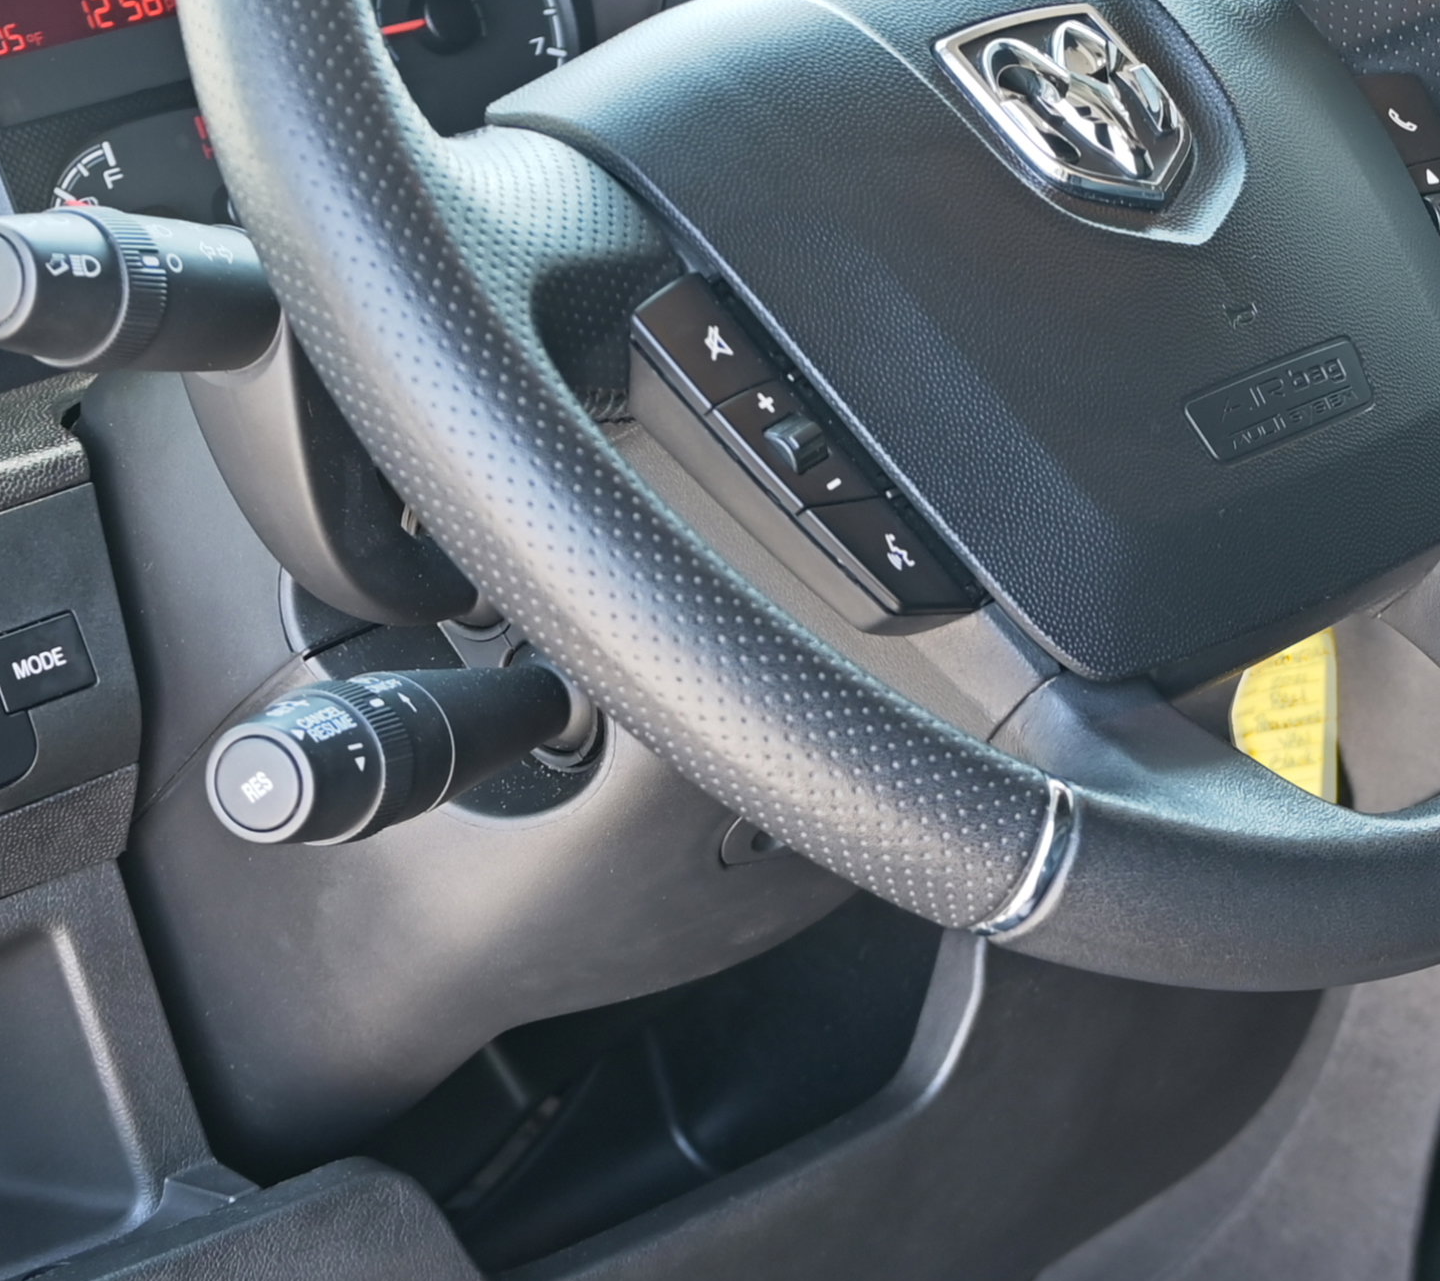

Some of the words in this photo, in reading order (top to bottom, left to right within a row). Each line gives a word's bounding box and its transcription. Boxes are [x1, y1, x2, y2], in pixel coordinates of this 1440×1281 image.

[529, 36, 545, 56] 7
[103, 168, 123, 189] F
[11, 646, 67, 680] MODE
[296, 706, 347, 729] CANCEL
[307, 714, 358, 743] RESUME
[241, 771, 274, 804] RES
